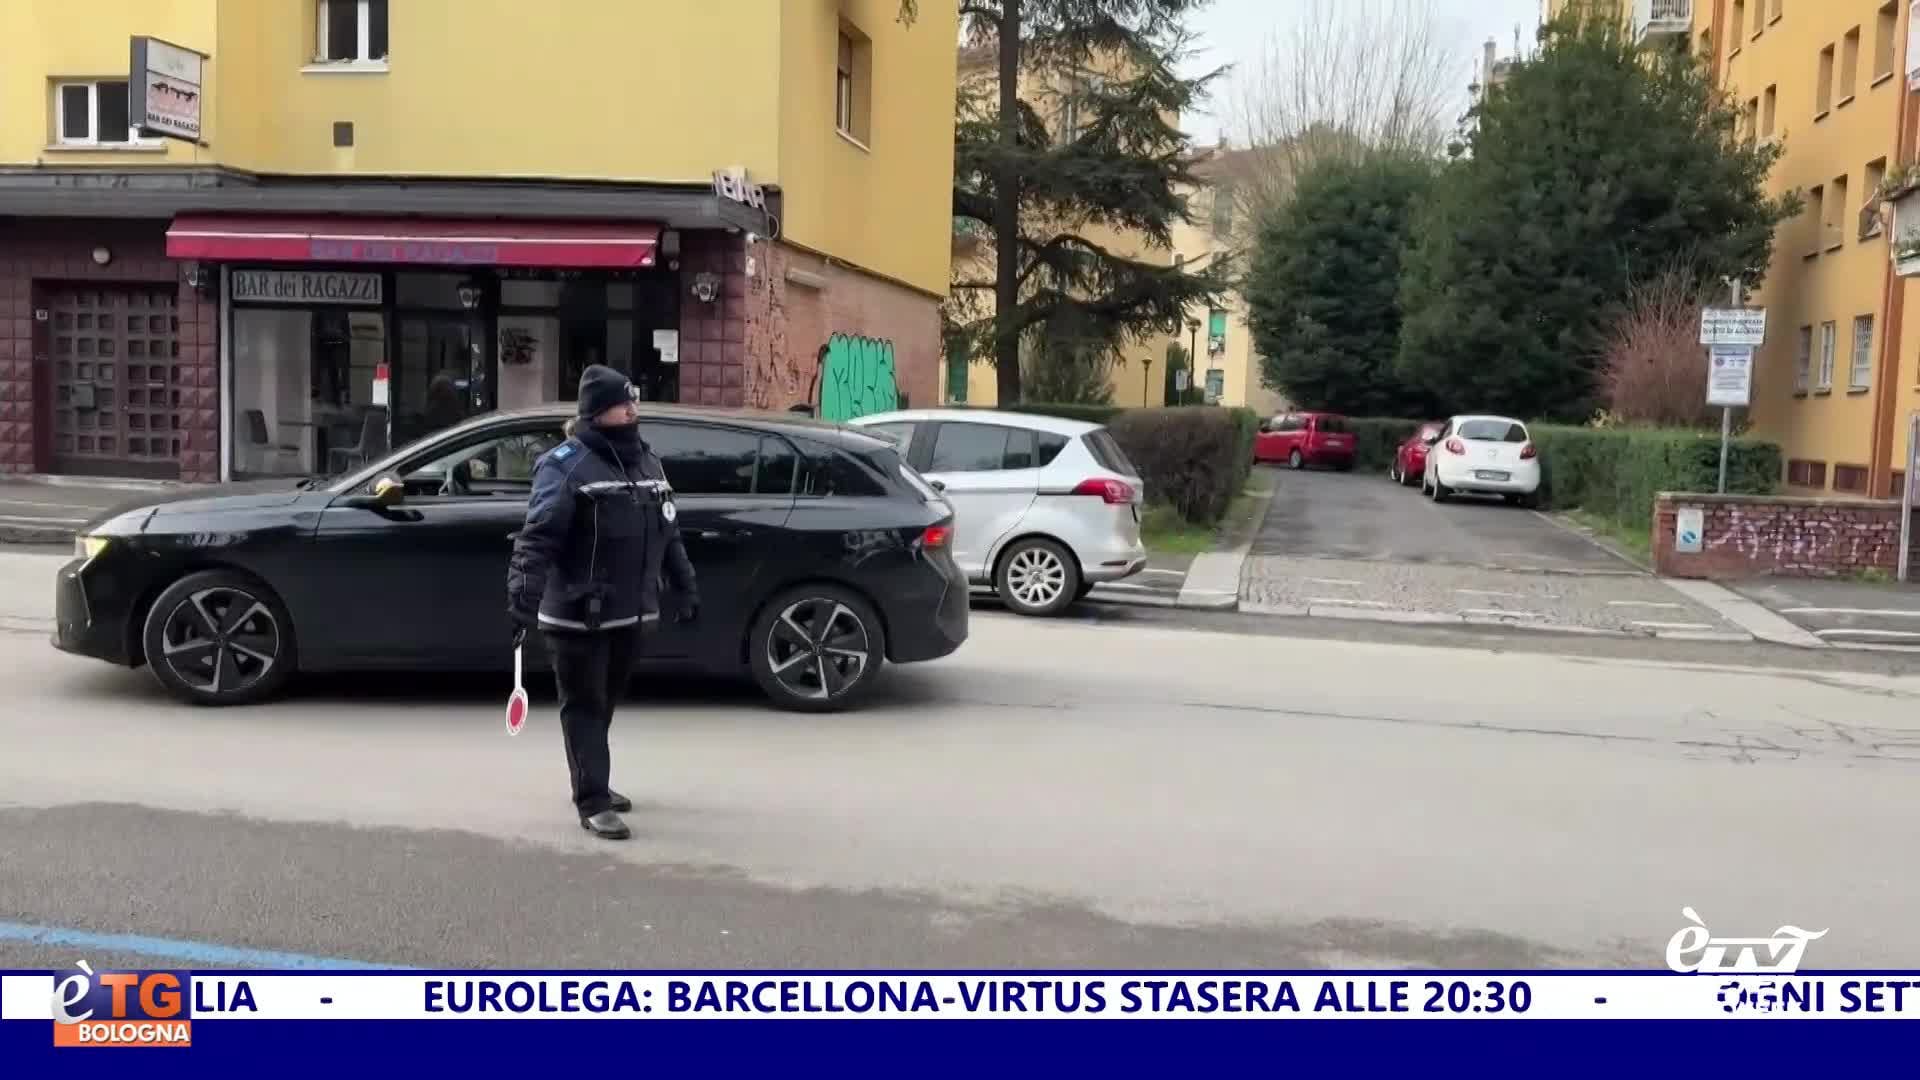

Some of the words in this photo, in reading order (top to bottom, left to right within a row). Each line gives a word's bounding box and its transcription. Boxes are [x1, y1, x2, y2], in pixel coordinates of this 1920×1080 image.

[718, 169, 766, 209] BAR
[233, 271, 269, 296] BAR
[274, 272, 297, 297] dei
[302, 274, 379, 300] RAGAZZI
